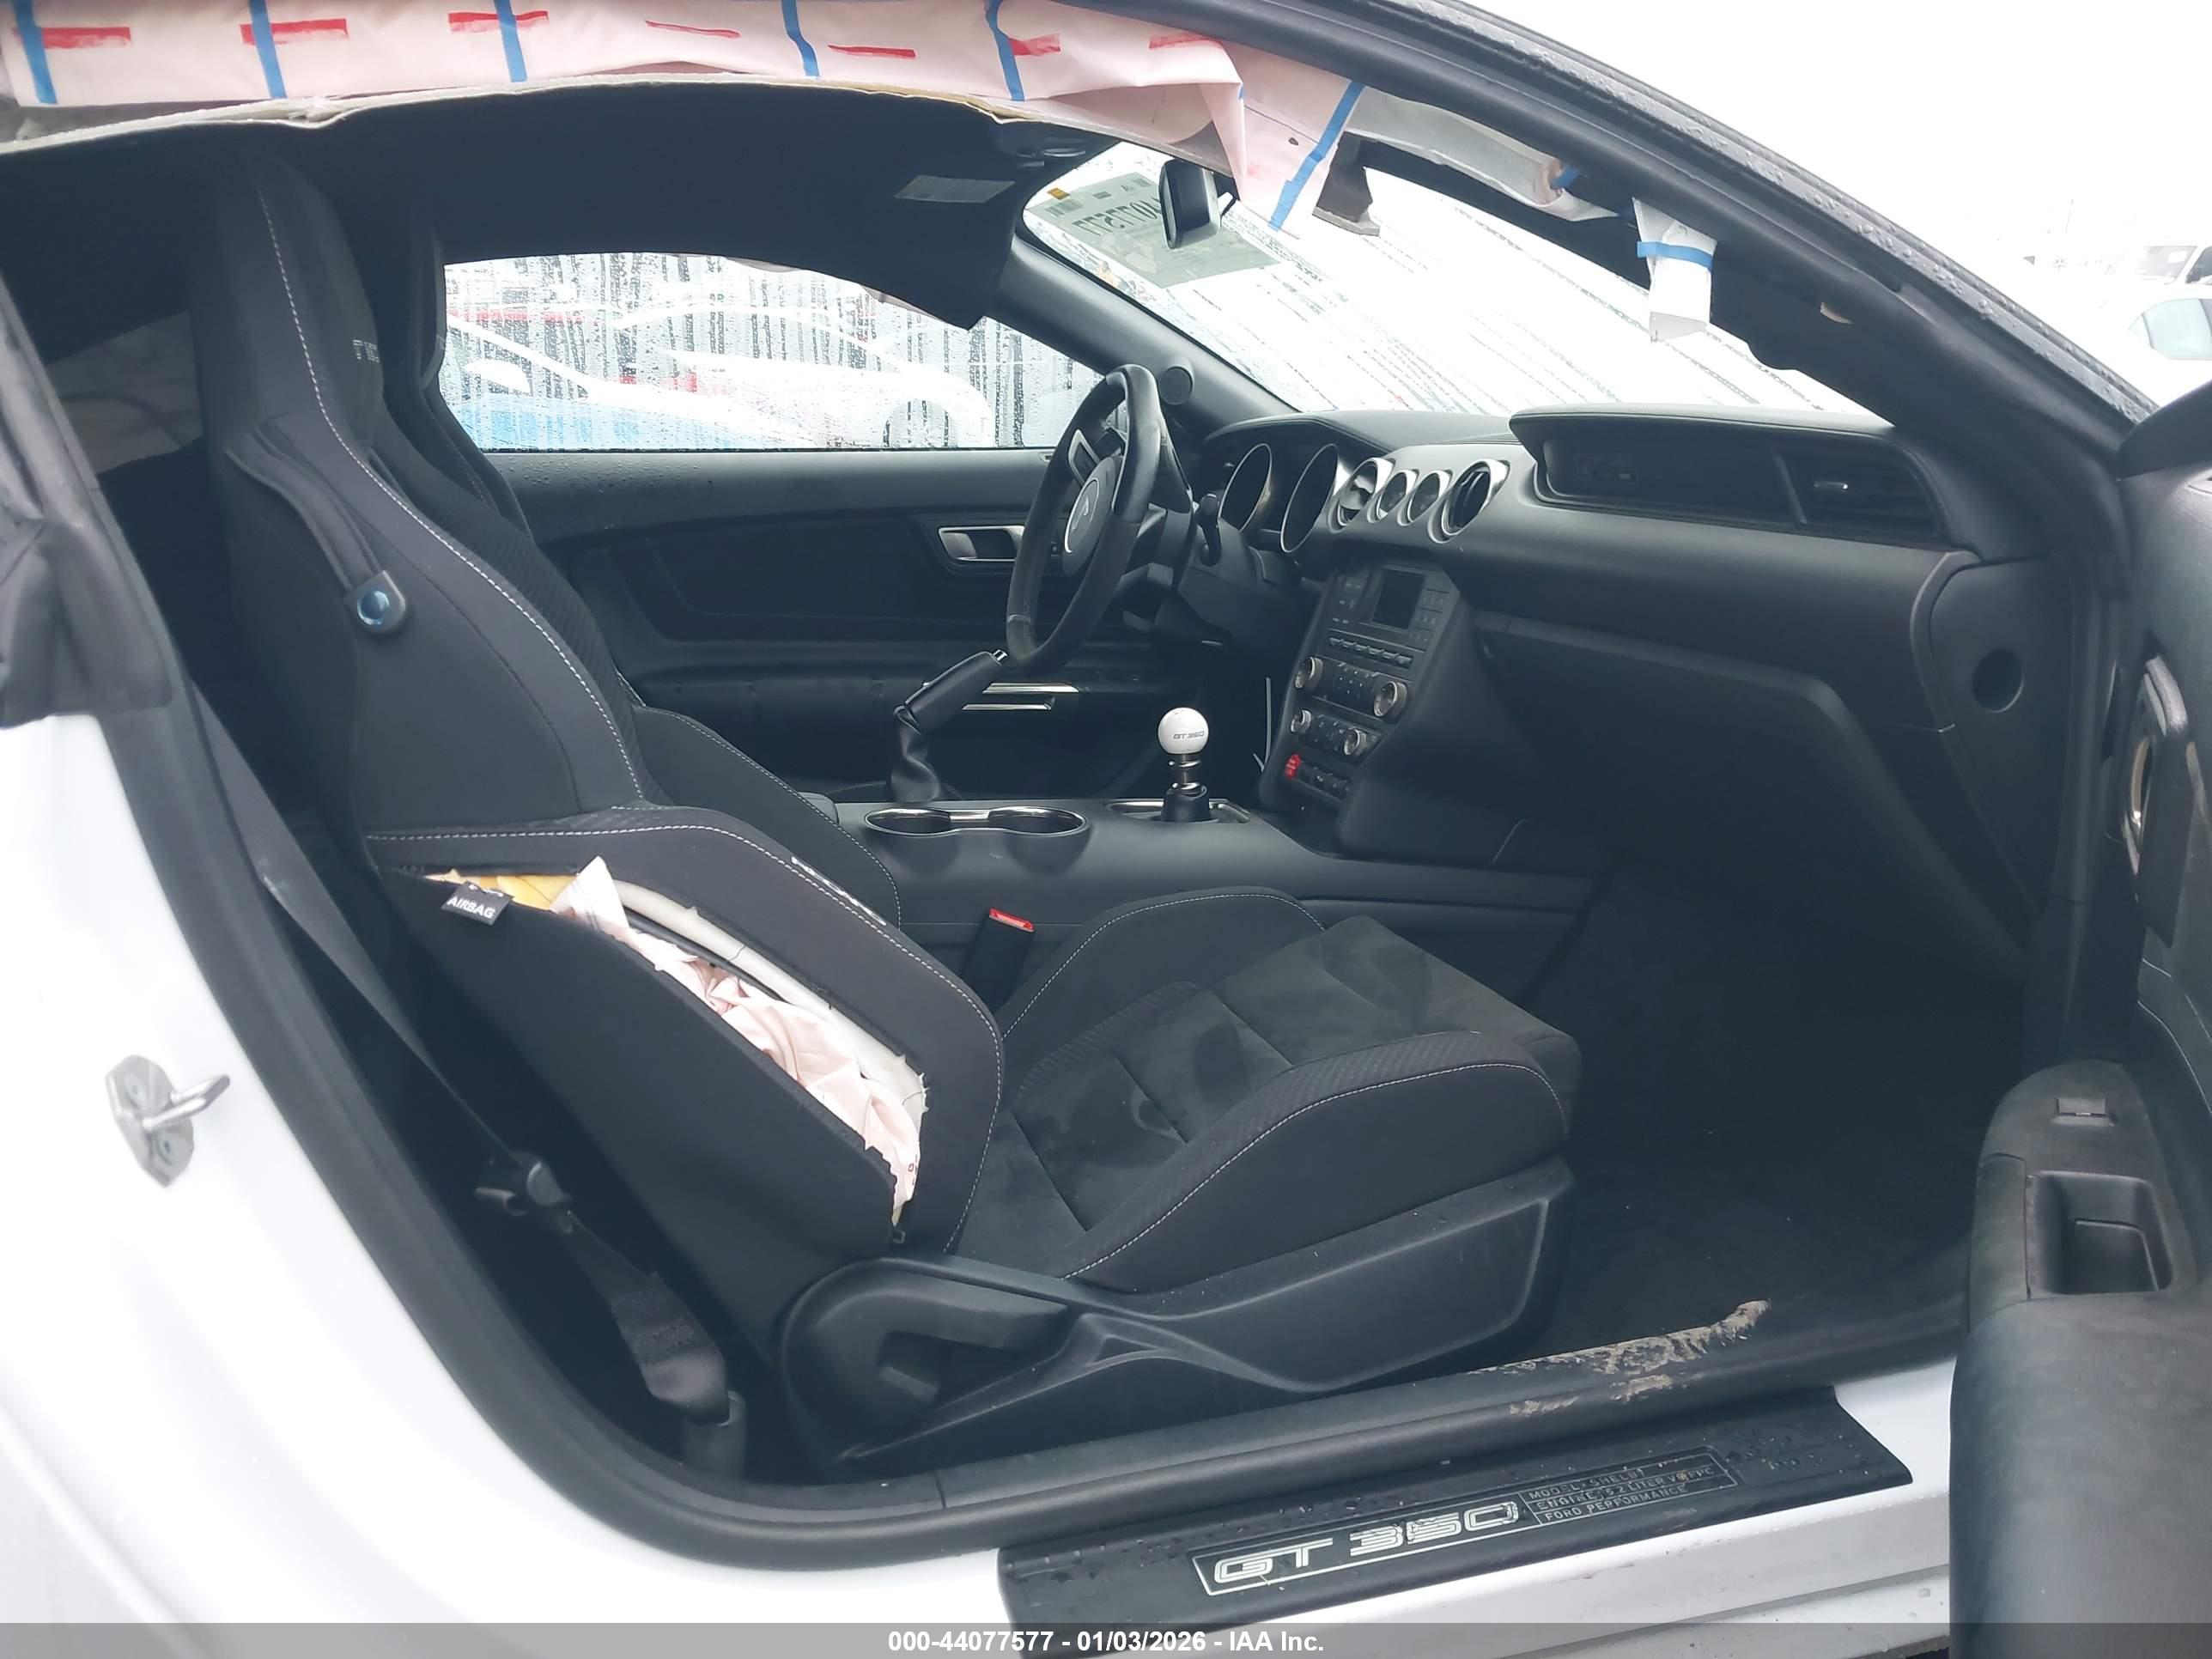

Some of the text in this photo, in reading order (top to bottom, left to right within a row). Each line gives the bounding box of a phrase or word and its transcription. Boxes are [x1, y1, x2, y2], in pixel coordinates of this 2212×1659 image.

[446, 896, 496, 919] AIRBAG
[1545, 1485, 1688, 1521] FORD PERFORMANCE
[1214, 1501, 1519, 1583] GT 350
